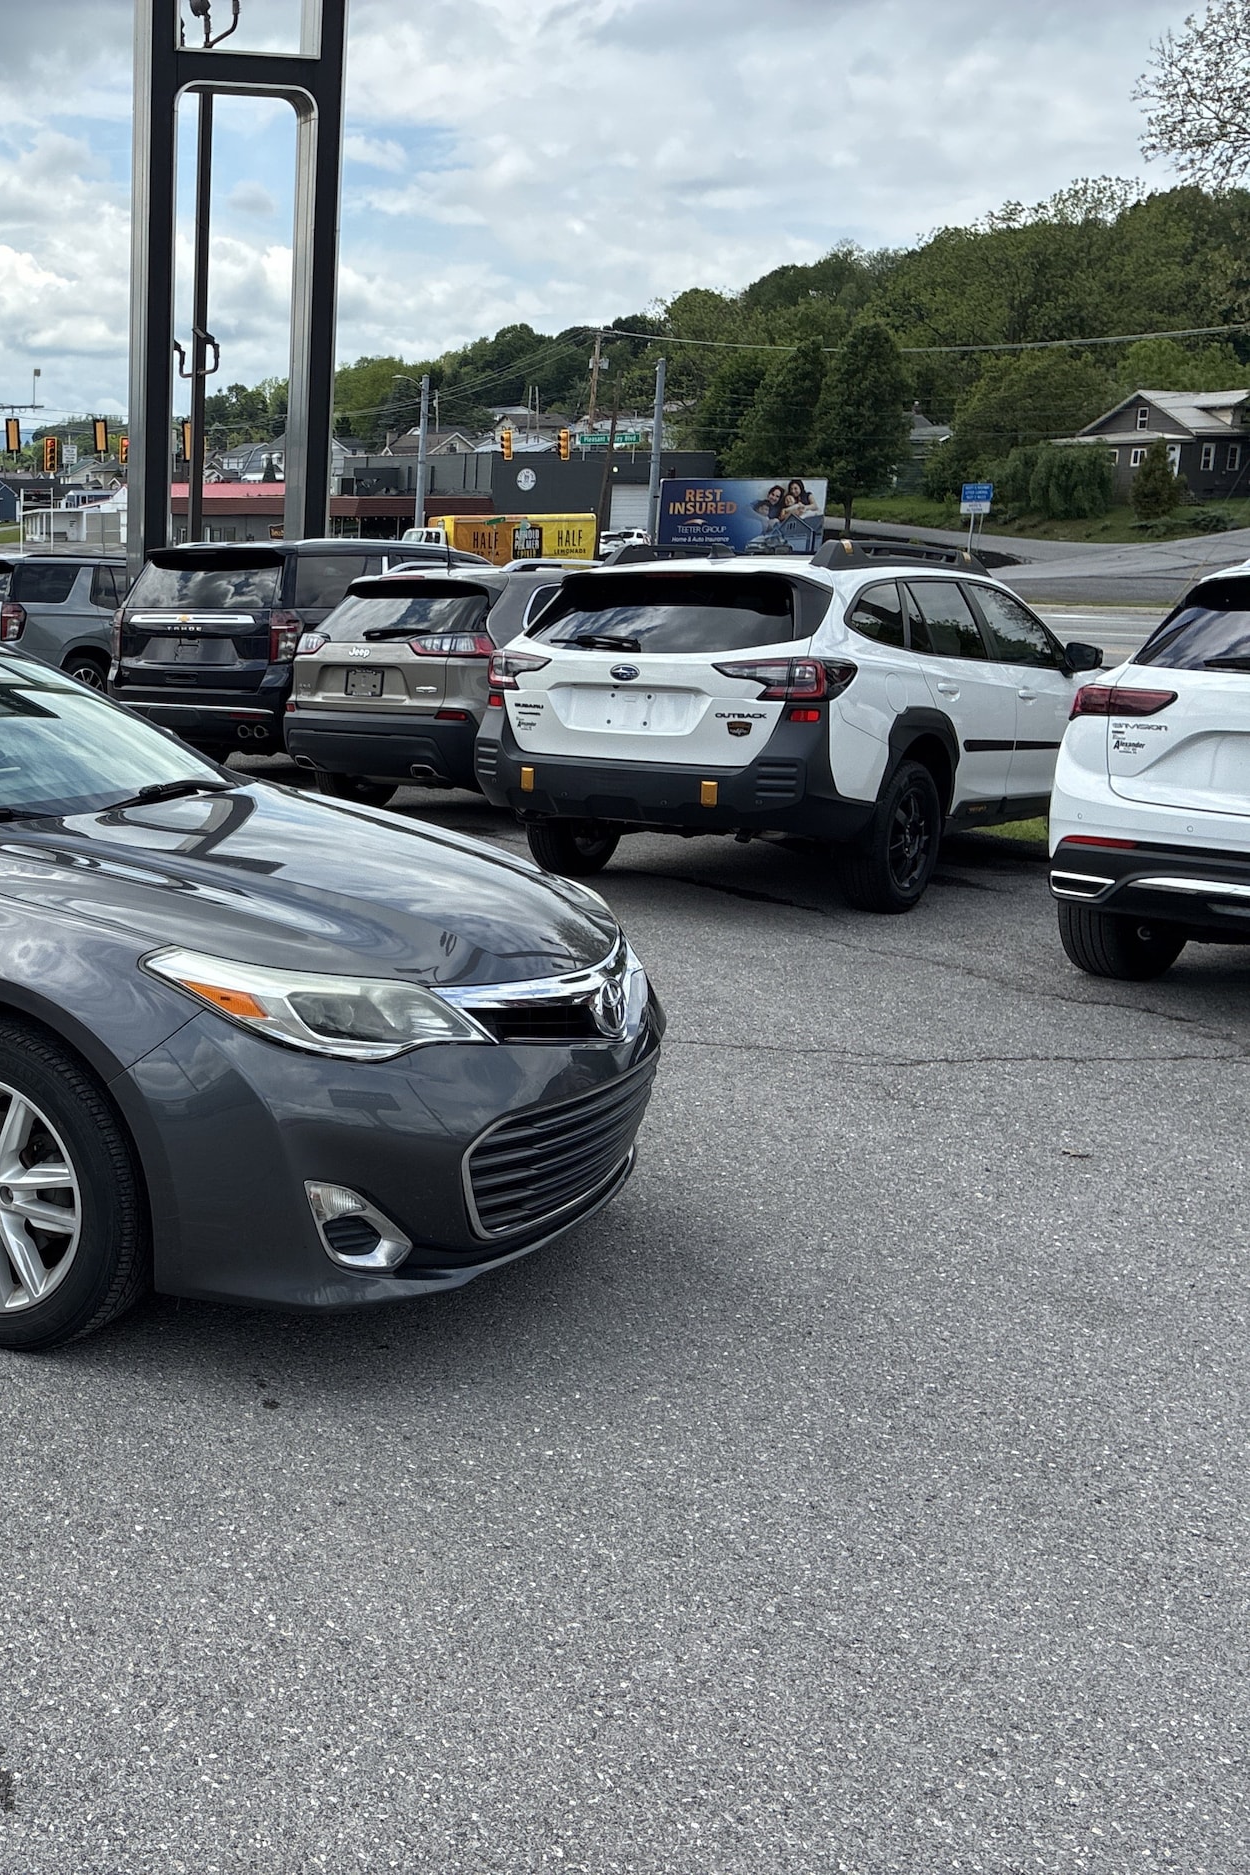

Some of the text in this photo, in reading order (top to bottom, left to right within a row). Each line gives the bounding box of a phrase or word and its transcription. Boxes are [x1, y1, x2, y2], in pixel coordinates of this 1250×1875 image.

[583, 435, 606, 443] Pleasant
[625, 433, 637, 442] Blvd
[685, 489, 723, 501] REST
[669, 502, 737, 514] INSURED
[677, 525, 727, 533] TEETER GROUP
[473, 532, 499, 549] HALF
[557, 529, 583, 546] HALF
[349, 647, 370, 658] Jeep
[1113, 740, 1146, 750] Alexander
